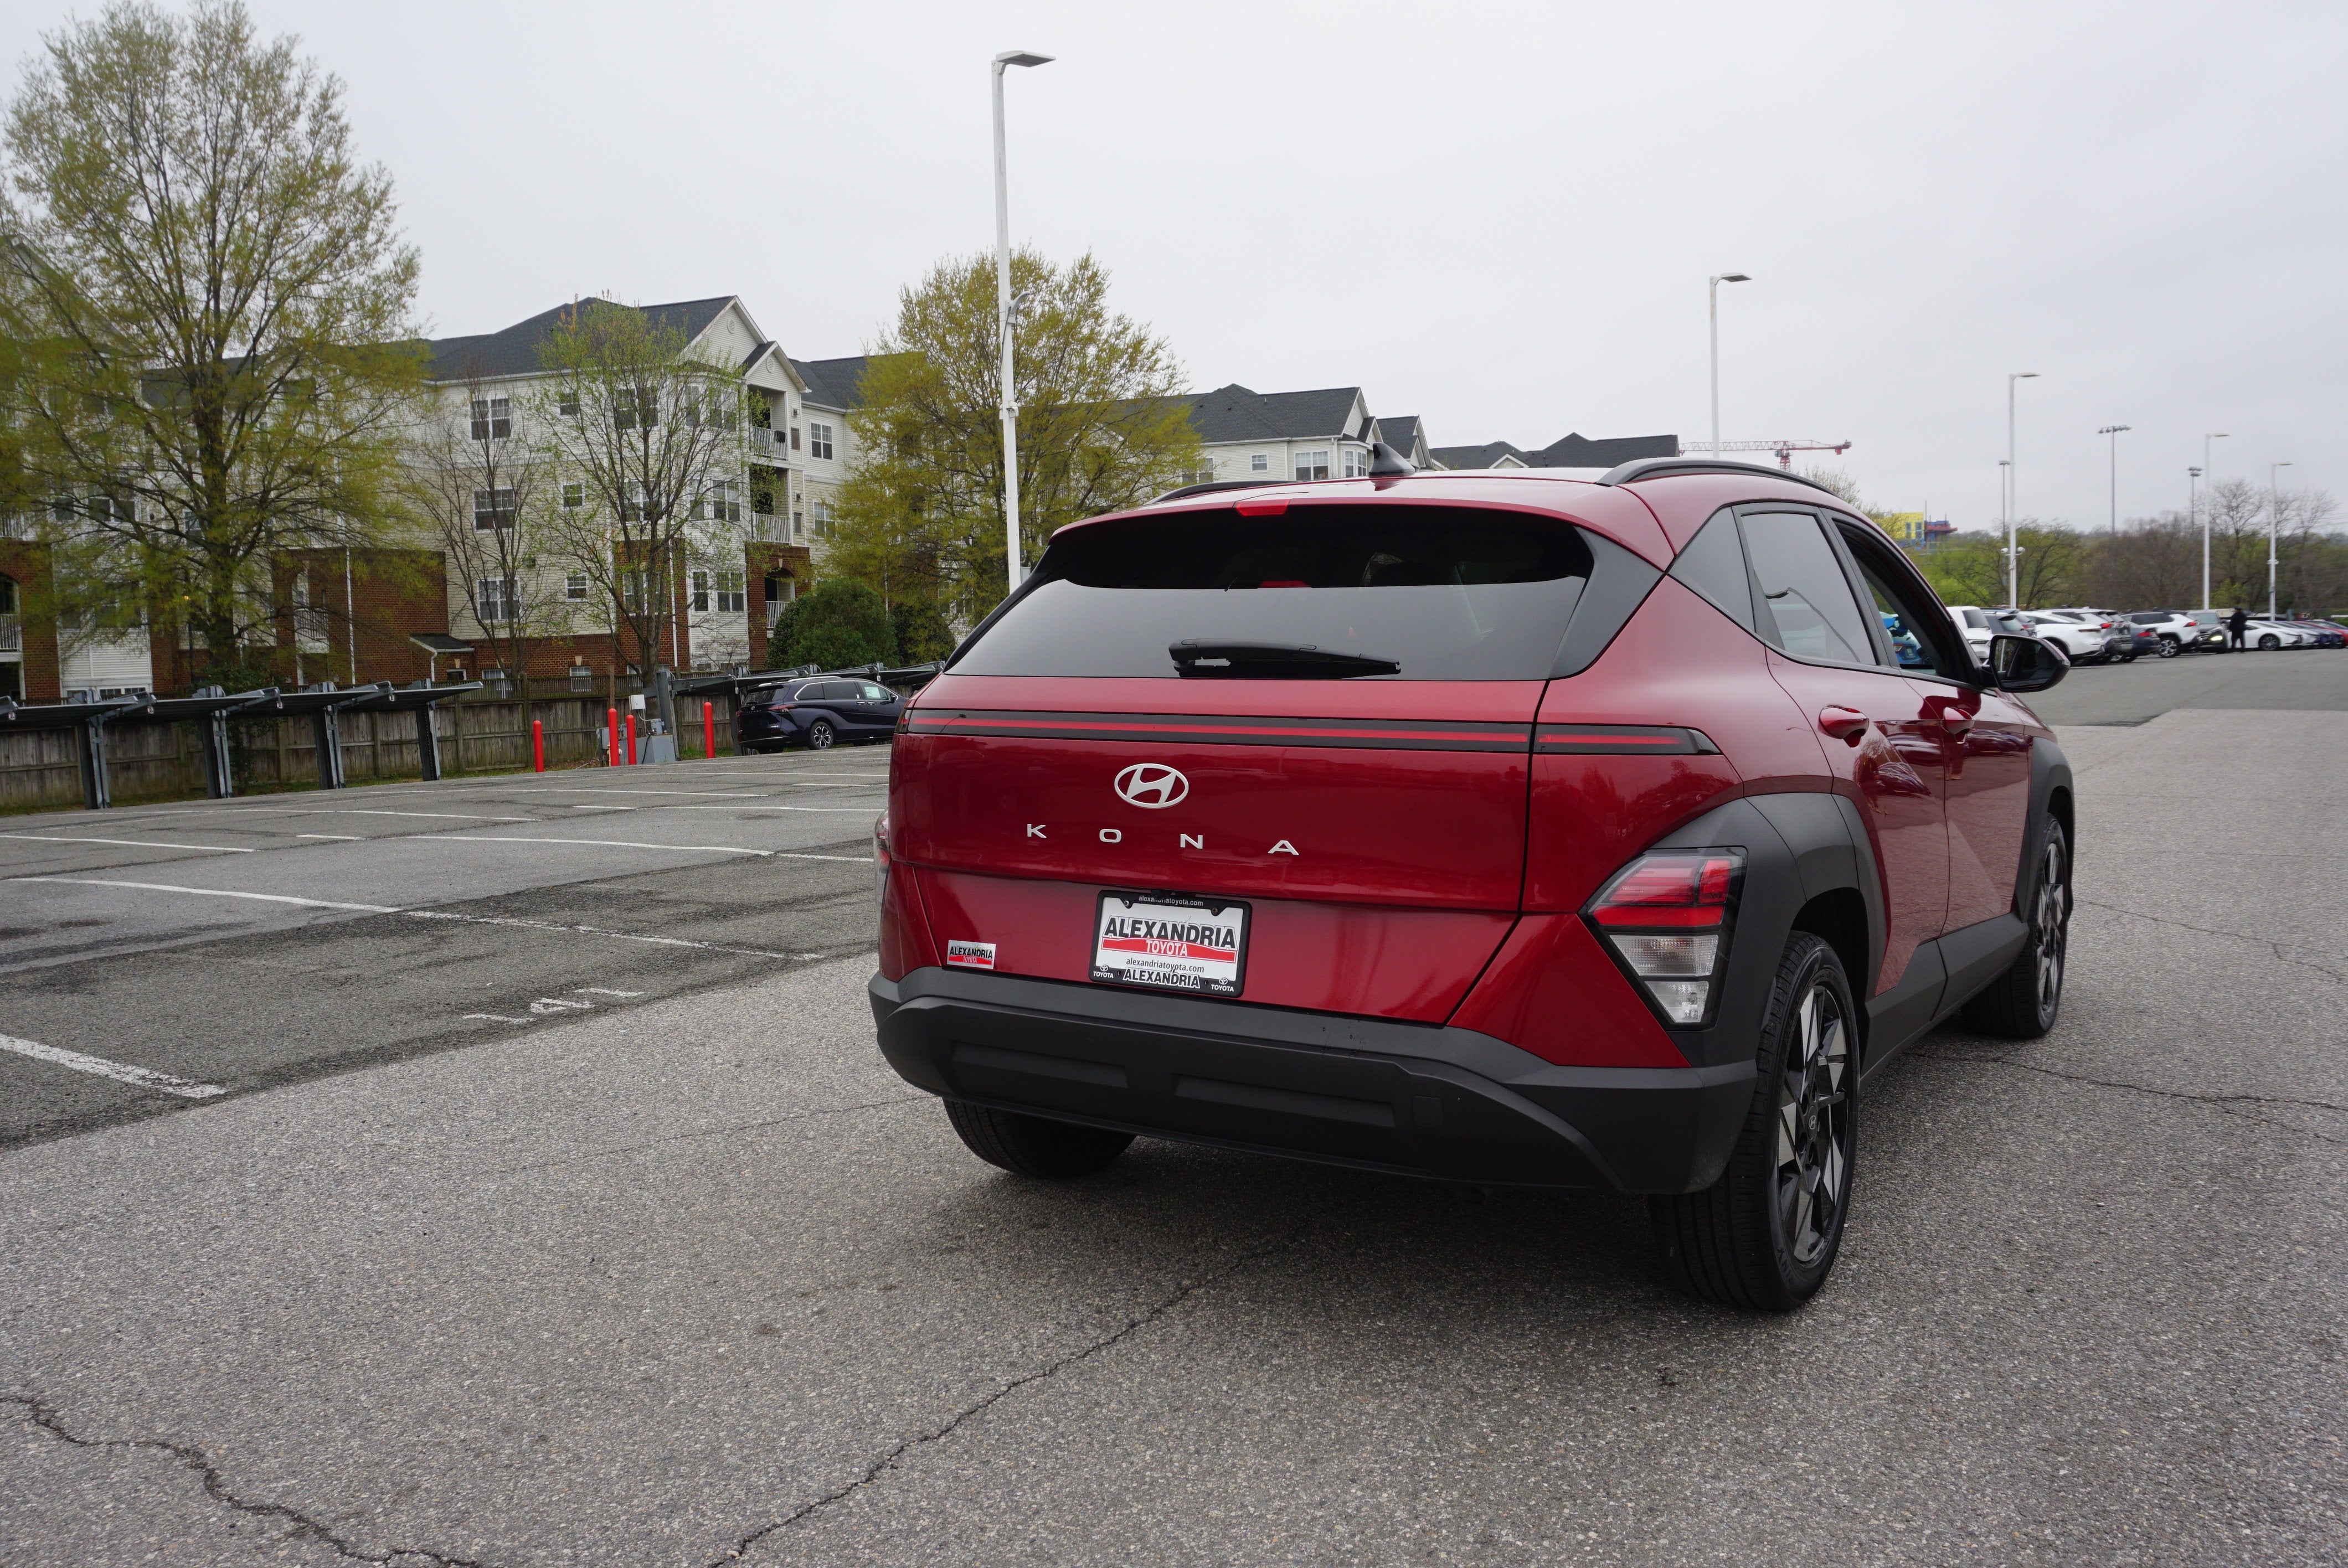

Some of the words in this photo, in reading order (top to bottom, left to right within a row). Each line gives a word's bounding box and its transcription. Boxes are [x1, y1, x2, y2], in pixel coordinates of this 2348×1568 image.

[1027, 824, 1299, 856] KONA
[1104, 917, 1235, 949] ALEXANDRIA
[949, 947, 992, 959] ALEXANDRIA
[1146, 940, 1188, 956] TOYOTA
[1126, 958, 1204, 973] alexandriatoyota.com
[1093, 971, 1114, 979] TOYOTA
[1124, 969, 1199, 988] ALEXANDRIA
[1211, 984, 1234, 992] TOYOTA
